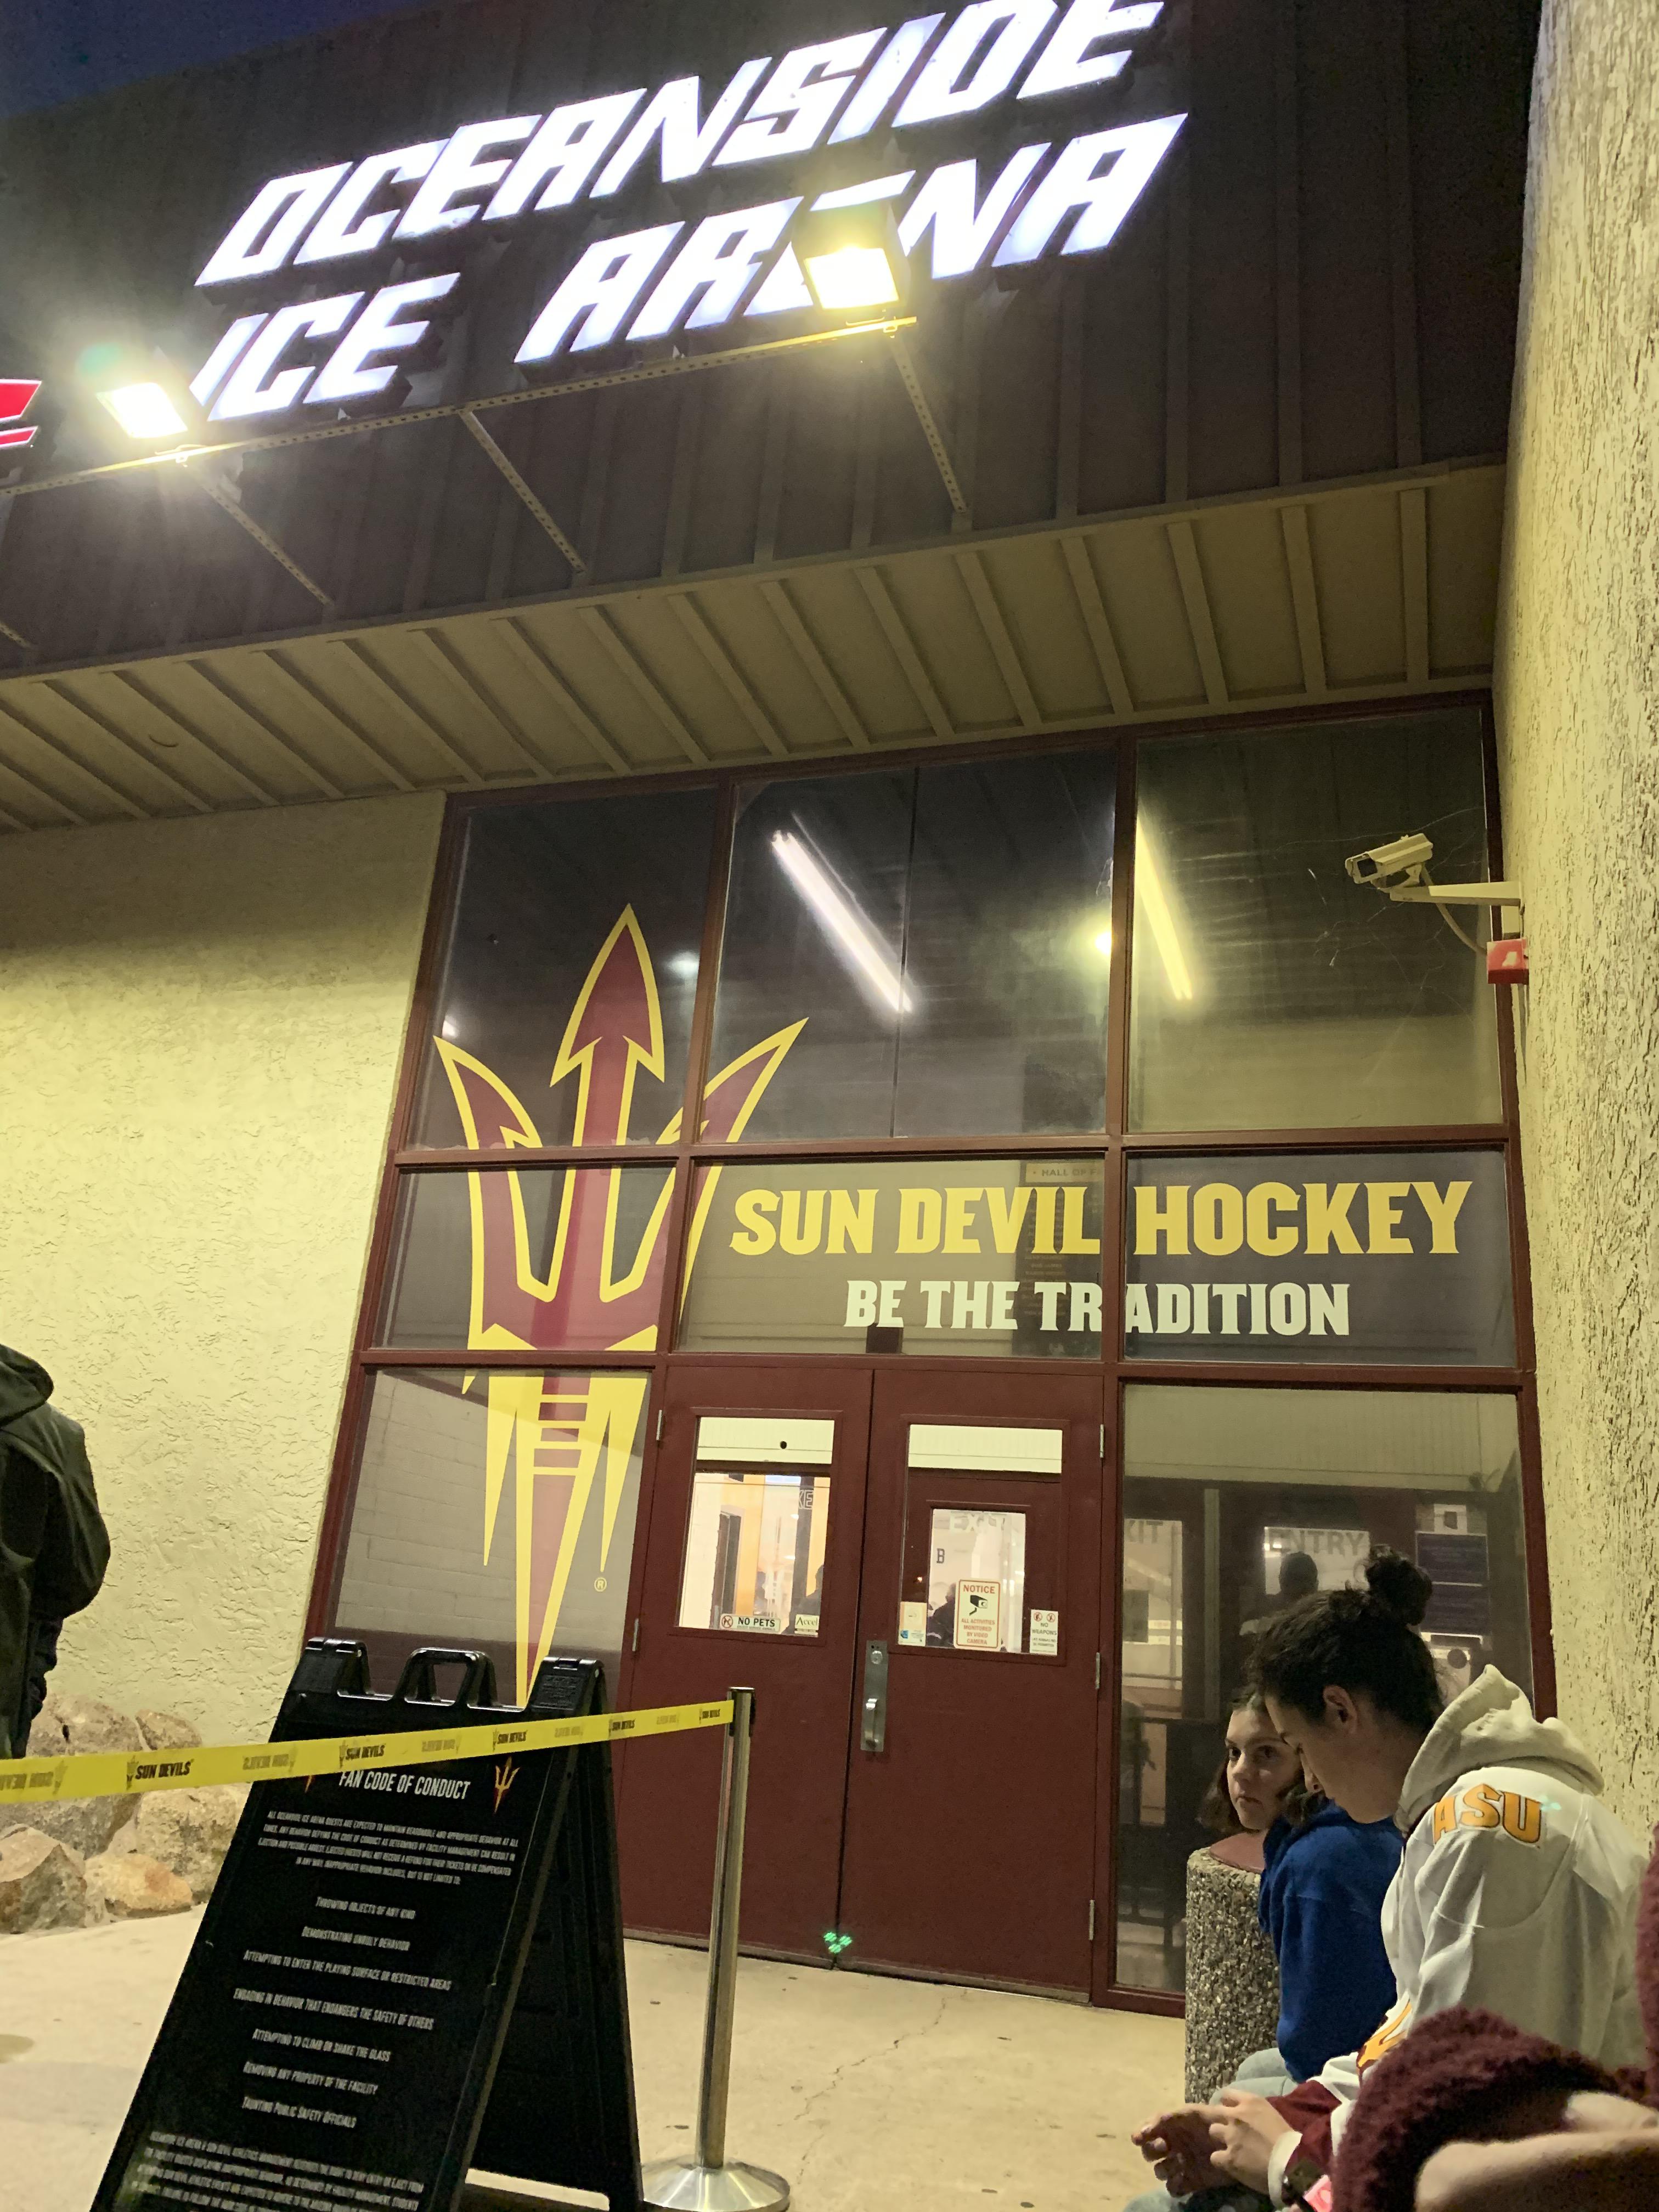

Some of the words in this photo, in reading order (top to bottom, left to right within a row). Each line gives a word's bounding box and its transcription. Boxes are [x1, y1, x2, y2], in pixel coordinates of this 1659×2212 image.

[194, 0, 1164, 286] OCEANSIDE
[189, 273, 461, 421] ICE
[1042, 1169, 1070, 1177] HALL
[729, 1189, 878, 1255] SUN
[896, 1186, 1101, 1256] DEVIL
[1133, 1181, 1473, 1257] HOCKEY
[844, 1280, 907, 1328] BE
[919, 1281, 1019, 1331] THE
[1034, 1282, 1350, 1335] TRADITION
[963, 1585, 995, 1594] NOTICE
[738, 1617, 750, 1625] NO
[754, 1618, 775, 1627] PETS
[136, 1764, 158, 1779] SUN
[159, 1761, 191, 1778] DEVILS
[338, 1771, 364, 1788] FAN
[364, 1771, 397, 1791] CODE
[397, 1774, 415, 1793] OF
[414, 1776, 471, 1799] CONDUCT
[1434, 1783, 1542, 1844] ASU
